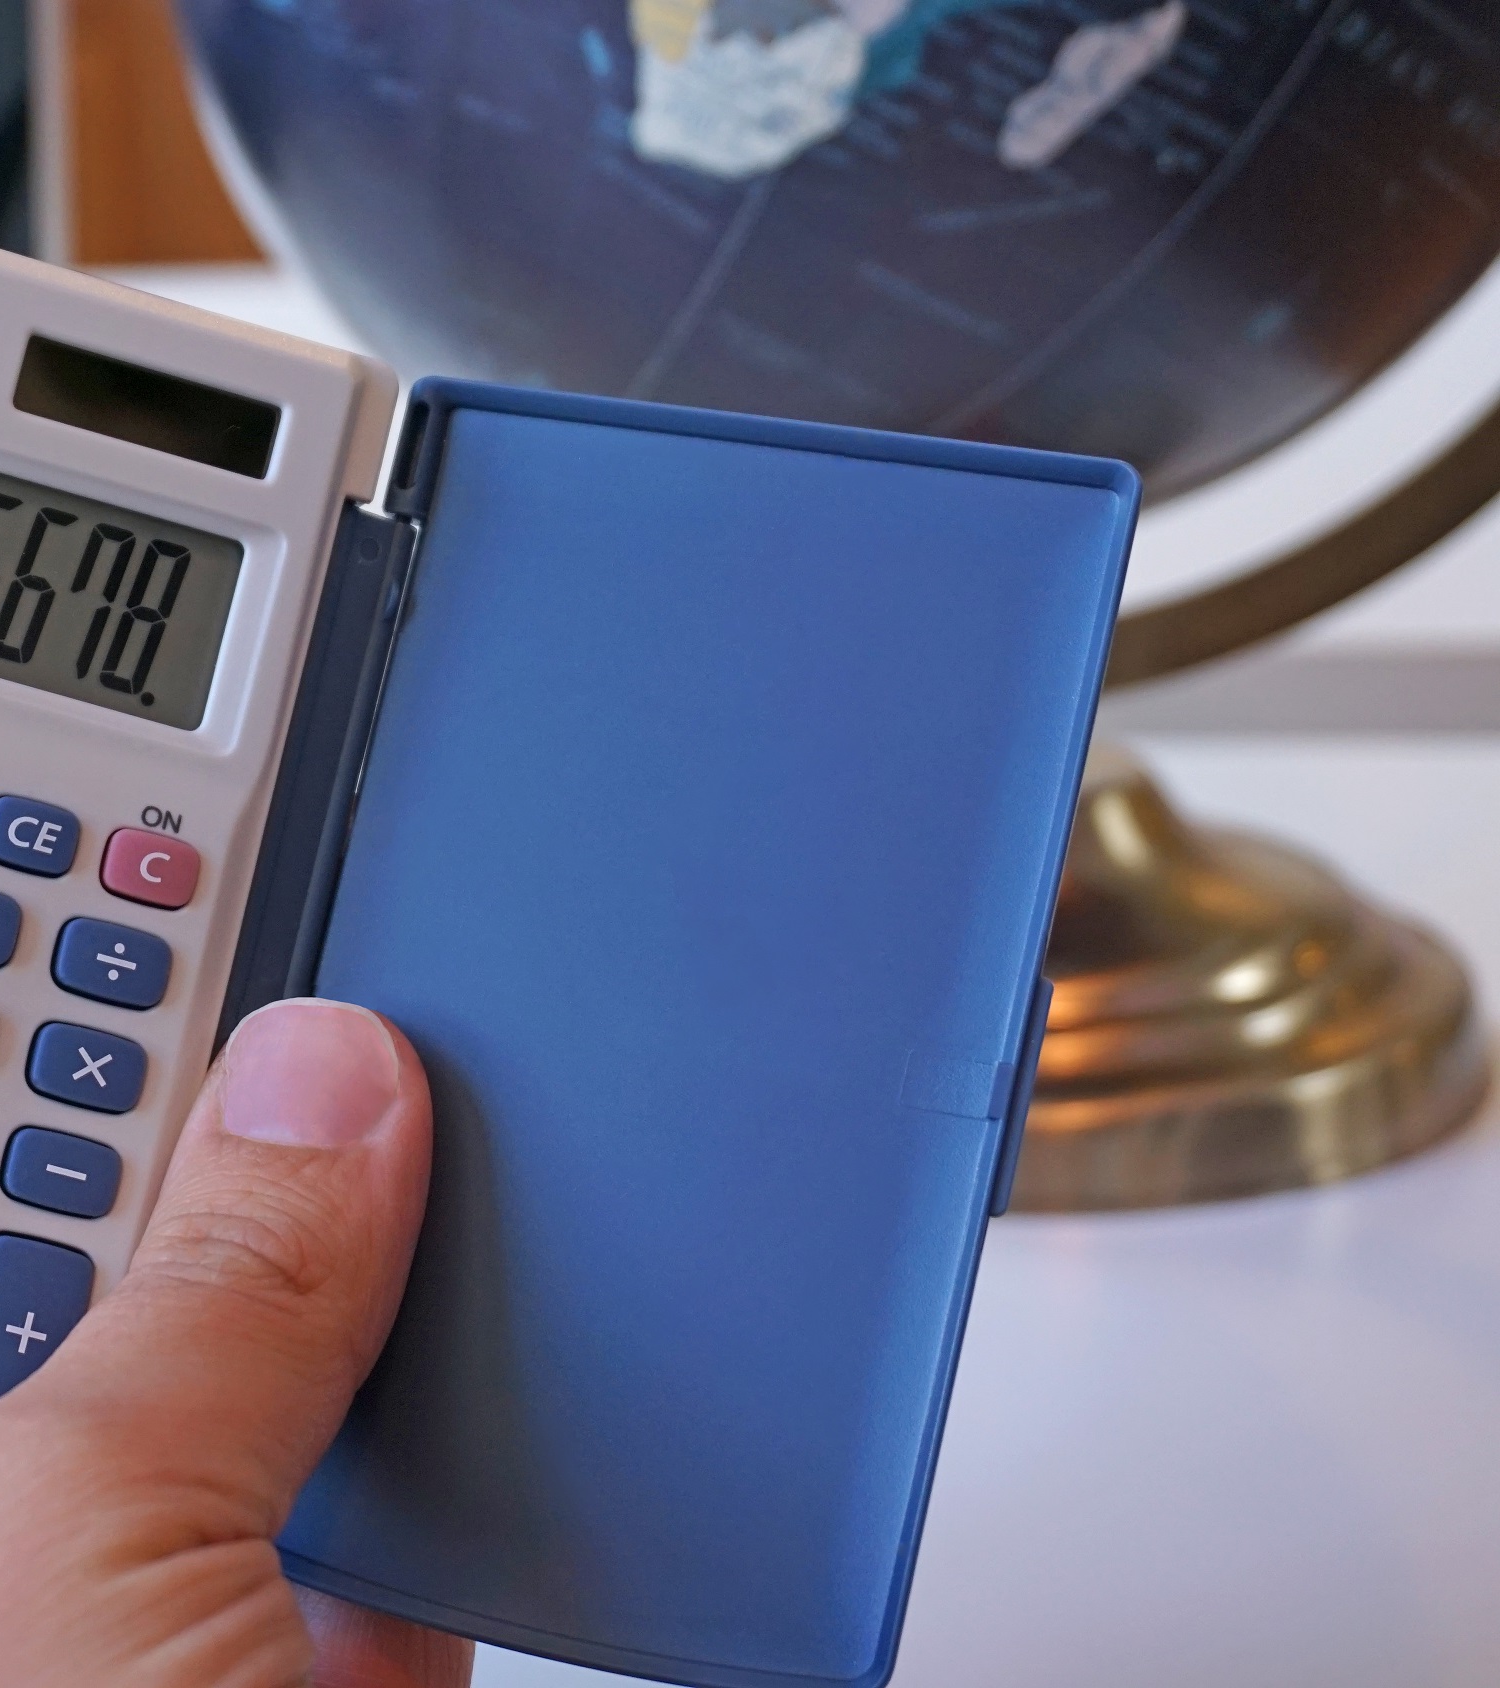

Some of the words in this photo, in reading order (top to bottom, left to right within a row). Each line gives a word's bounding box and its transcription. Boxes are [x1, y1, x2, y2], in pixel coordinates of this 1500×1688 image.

[7, 816, 62, 856] CE
[141, 805, 183, 834] ON
[139, 851, 170, 884] C
[5, 1311, 48, 1355] +
